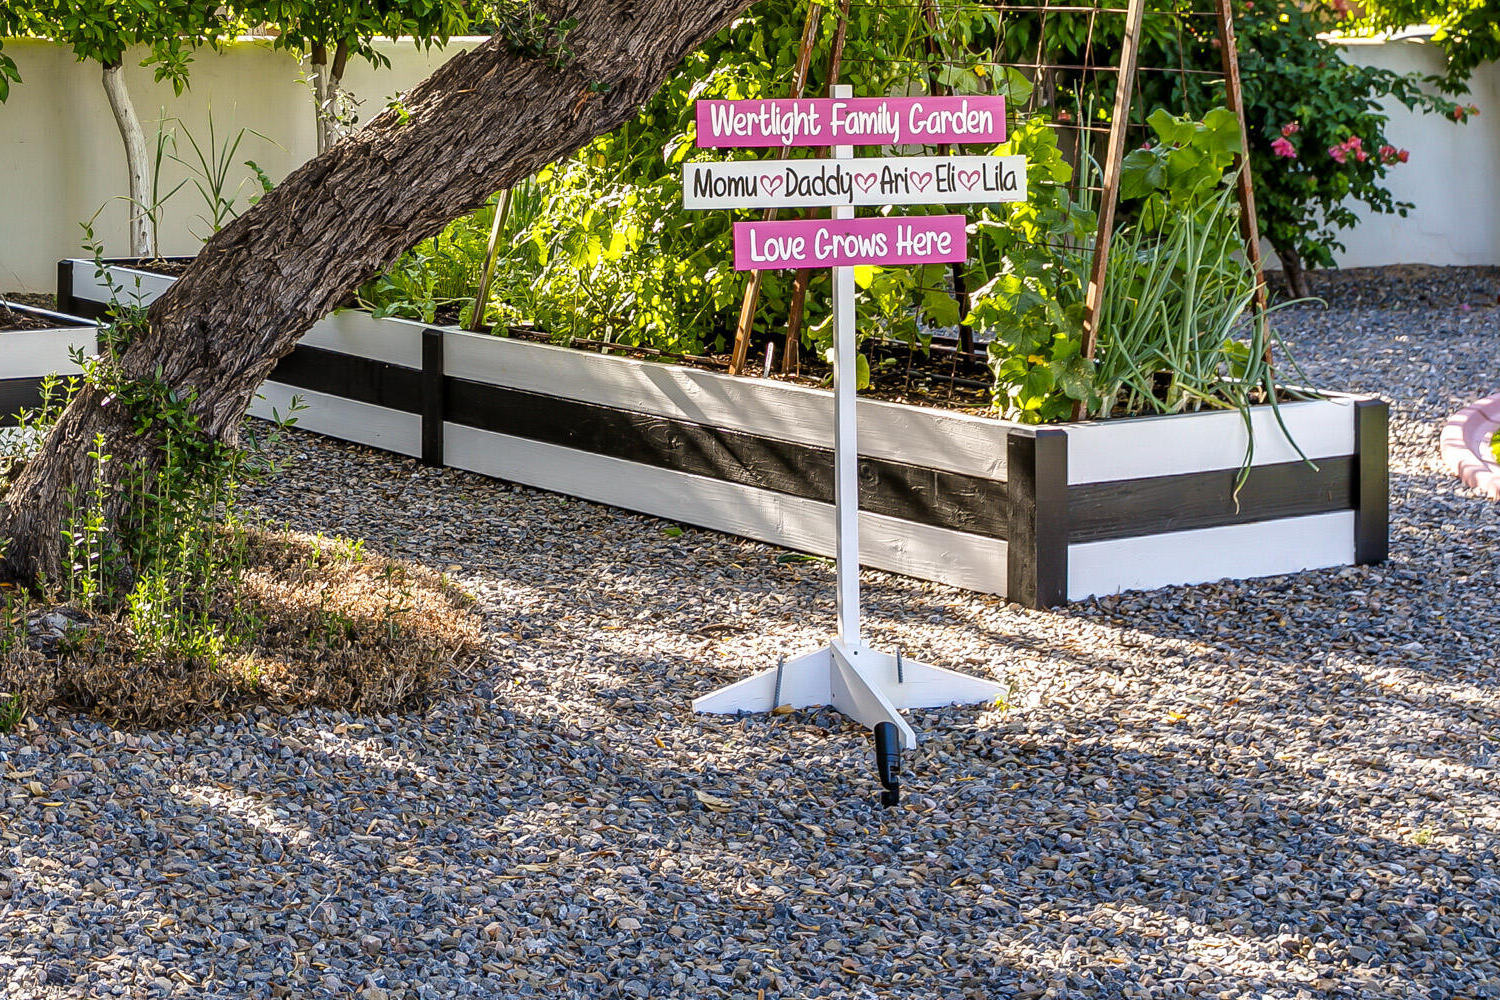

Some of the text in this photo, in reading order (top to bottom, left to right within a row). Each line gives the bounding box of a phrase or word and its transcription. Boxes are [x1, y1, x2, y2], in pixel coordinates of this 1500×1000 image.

[710, 99, 993, 146] Wertlight Family Garden
[693, 161, 1017, 203] Momu Daddy Ari Eli Lila
[749, 224, 952, 263] Love Grows Here
